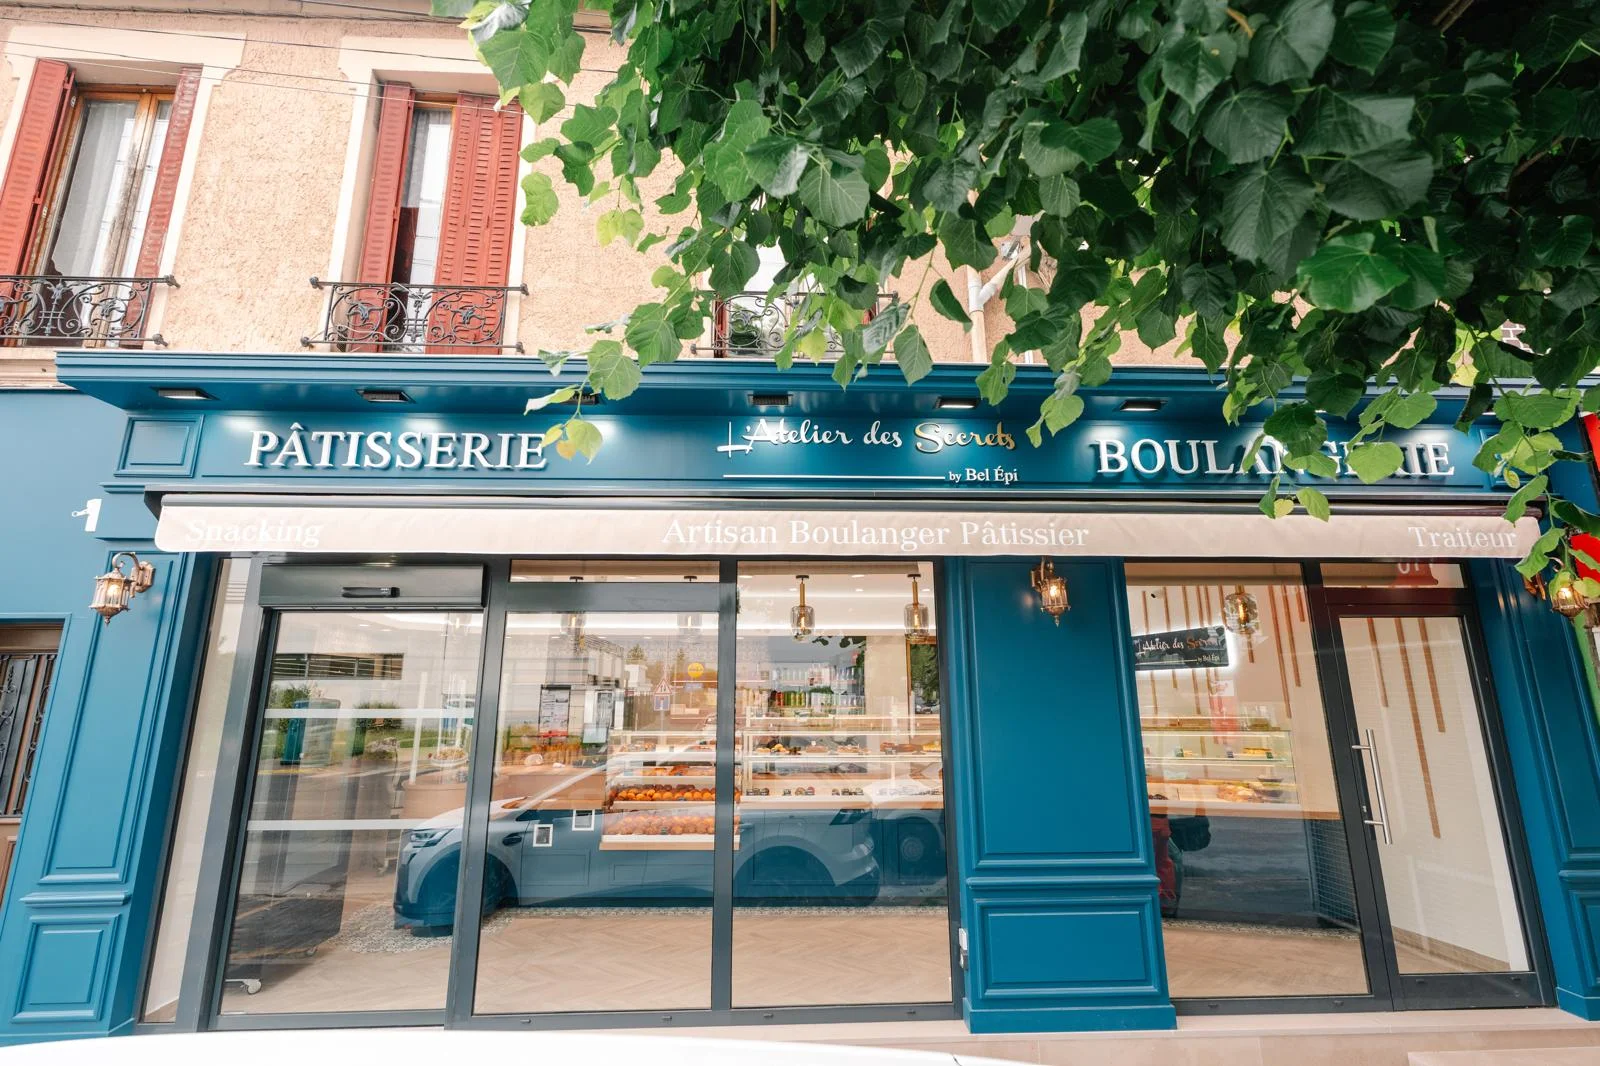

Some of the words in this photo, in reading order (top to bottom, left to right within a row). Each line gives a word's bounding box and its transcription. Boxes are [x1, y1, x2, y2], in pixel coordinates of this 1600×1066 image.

[243, 422, 548, 470] PÂTISSERIE
[717, 418, 854, 458] L'Atelier
[863, 420, 903, 448] des
[914, 421, 1016, 453] Secrets
[1096, 438, 1455, 476] BOULANIE
[949, 470, 962, 483] by
[965, 468, 989, 481] Bel
[994, 465, 1018, 485] Épi
[184, 519, 324, 548] Snacking
[662, 519, 777, 545] Artisan
[788, 519, 950, 551] Boulanger
[960, 520, 1090, 547] Pâtissier
[1407, 526, 1517, 548] Traiteur
